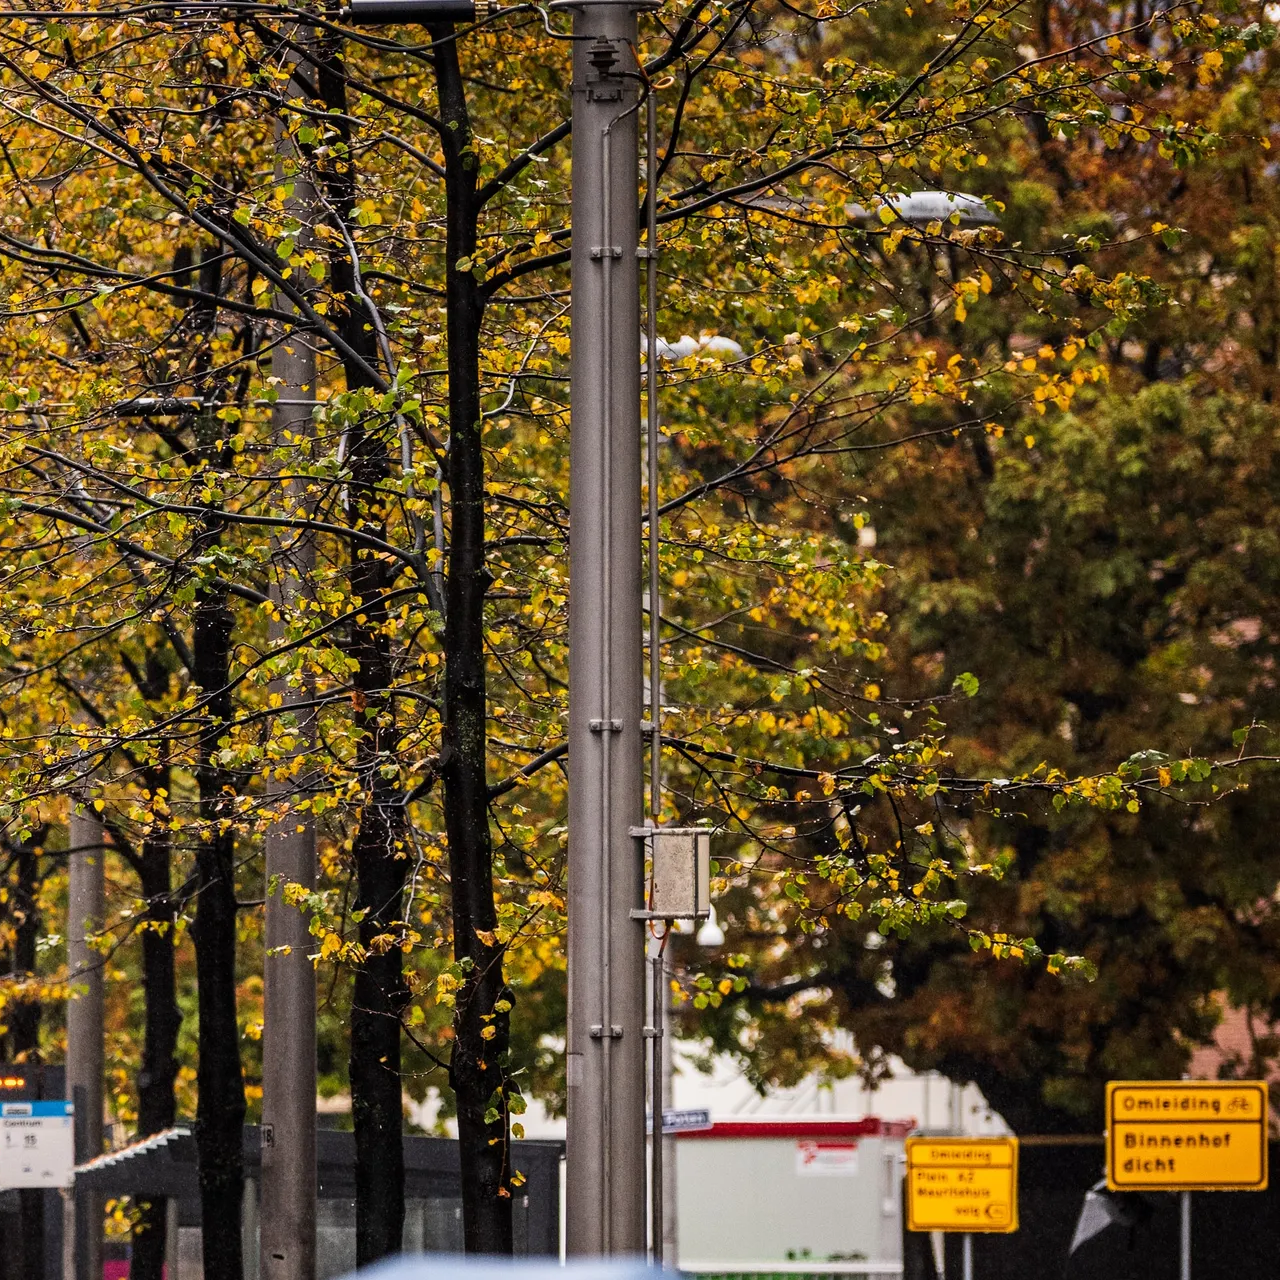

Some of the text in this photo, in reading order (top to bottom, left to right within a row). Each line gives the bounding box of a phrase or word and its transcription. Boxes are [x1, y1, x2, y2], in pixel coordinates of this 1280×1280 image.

[1123, 1096, 1221, 1114] Omleiding
[1124, 1132, 1231, 1149] Binnenhof
[1123, 1158, 1175, 1173] dicht
